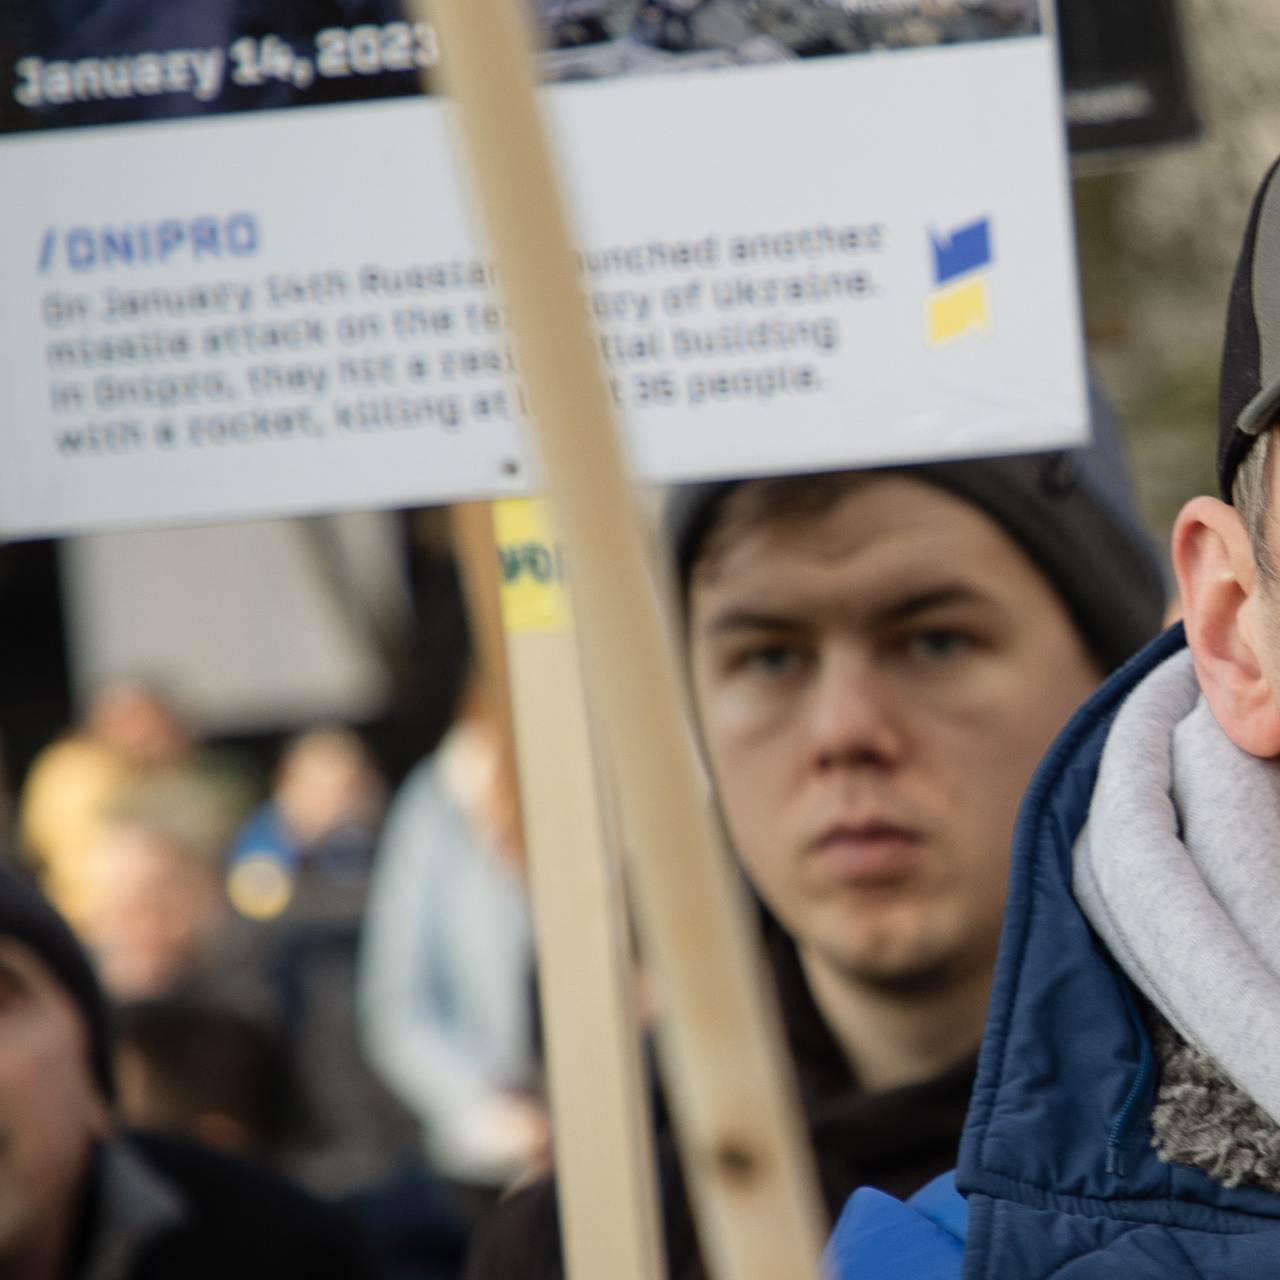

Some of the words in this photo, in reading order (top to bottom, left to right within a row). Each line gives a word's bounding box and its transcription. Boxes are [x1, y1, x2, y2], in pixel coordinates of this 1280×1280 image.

[16, 49, 224, 106] January
[231, 35, 313, 88] 14,
[316, 24, 438, 76] 2023
[38, 215, 258, 271] /DNIPRO
[104, 285, 251, 321] January
[731, 226, 884, 265] another
[50, 335, 190, 368] missile
[205, 320, 323, 356] attack
[339, 316, 382, 345] on
[393, 308, 452, 340] the
[664, 280, 701, 314] of
[249, 363, 326, 396] they
[340, 355, 395, 385] hit
[409, 354, 427, 382] a
[674, 316, 837, 358] building
[59, 422, 141, 454] with
[156, 419, 175, 447] a
[191, 408, 326, 446] rocket,
[336, 394, 461, 432] killing
[474, 389, 506, 421] at
[688, 363, 826, 405] people.
